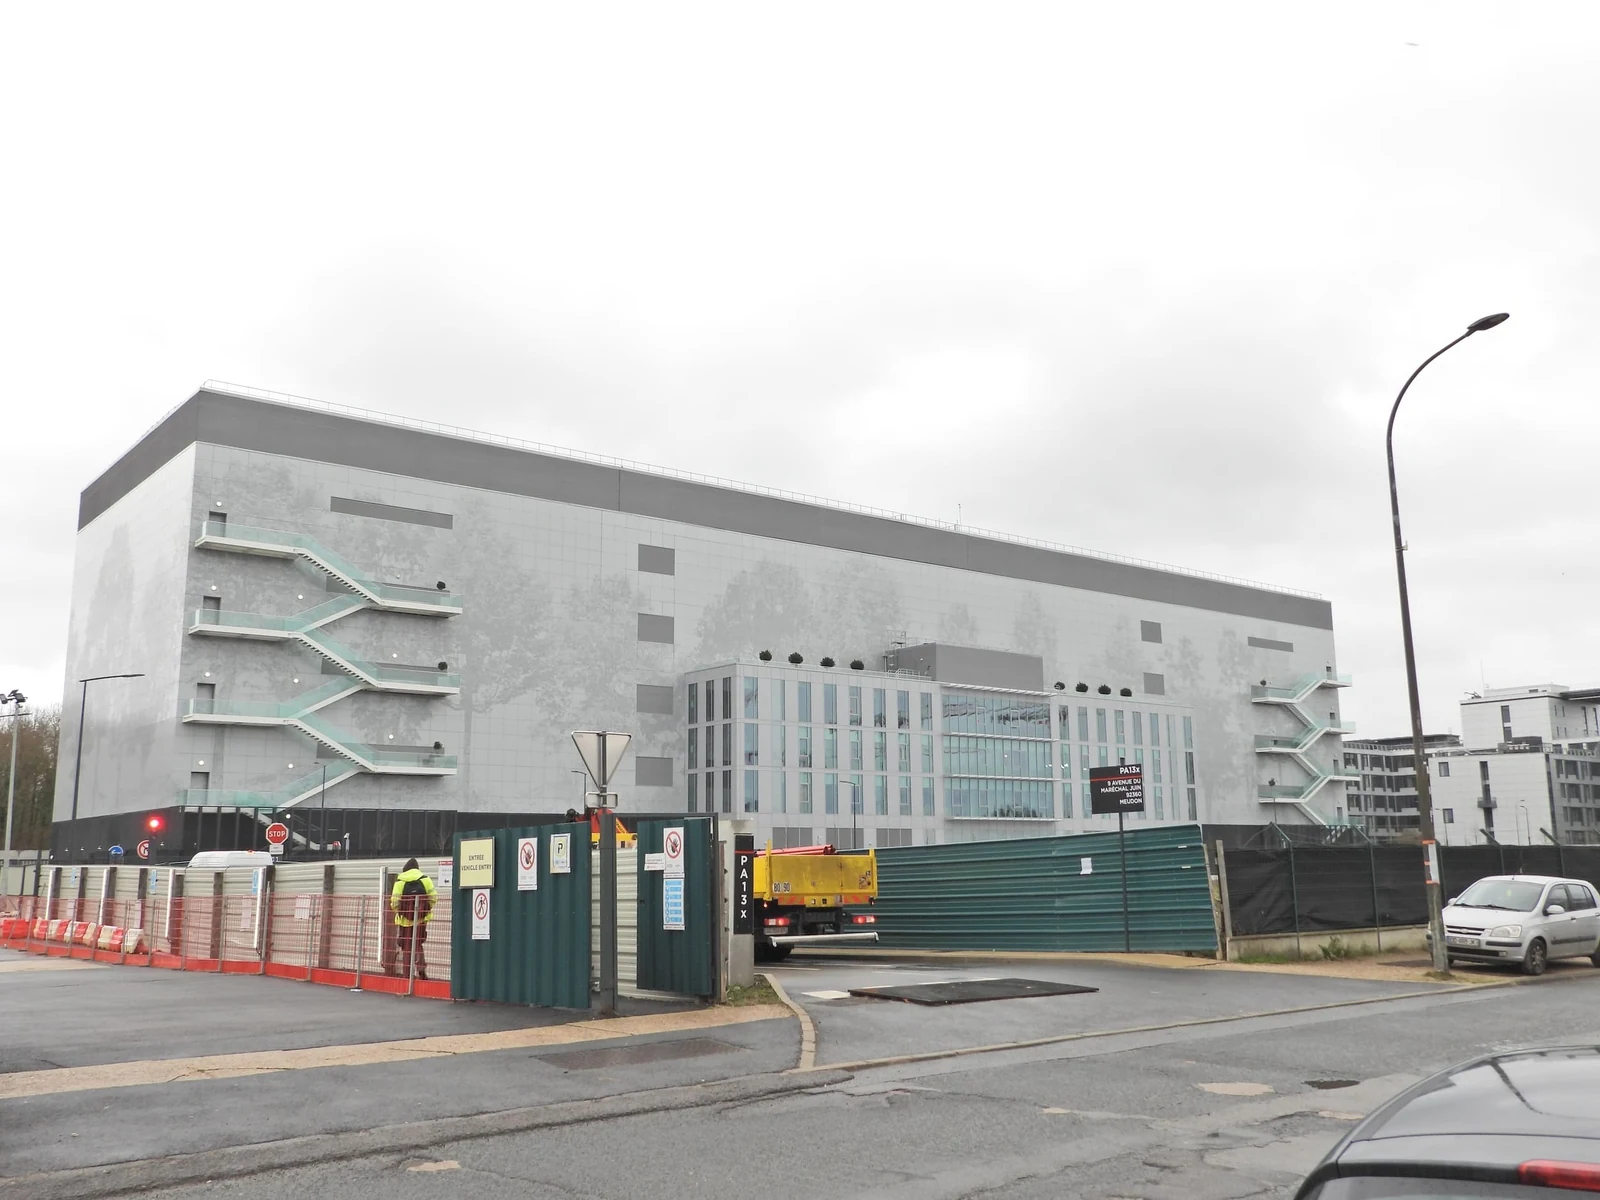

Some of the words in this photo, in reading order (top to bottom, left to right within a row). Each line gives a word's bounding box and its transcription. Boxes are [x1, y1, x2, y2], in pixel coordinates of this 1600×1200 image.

[1119, 766, 1141, 774] PA13x
[268, 830, 286, 838] STOP
[773, 882, 781, 893] 80
[783, 882, 791, 892] 90
